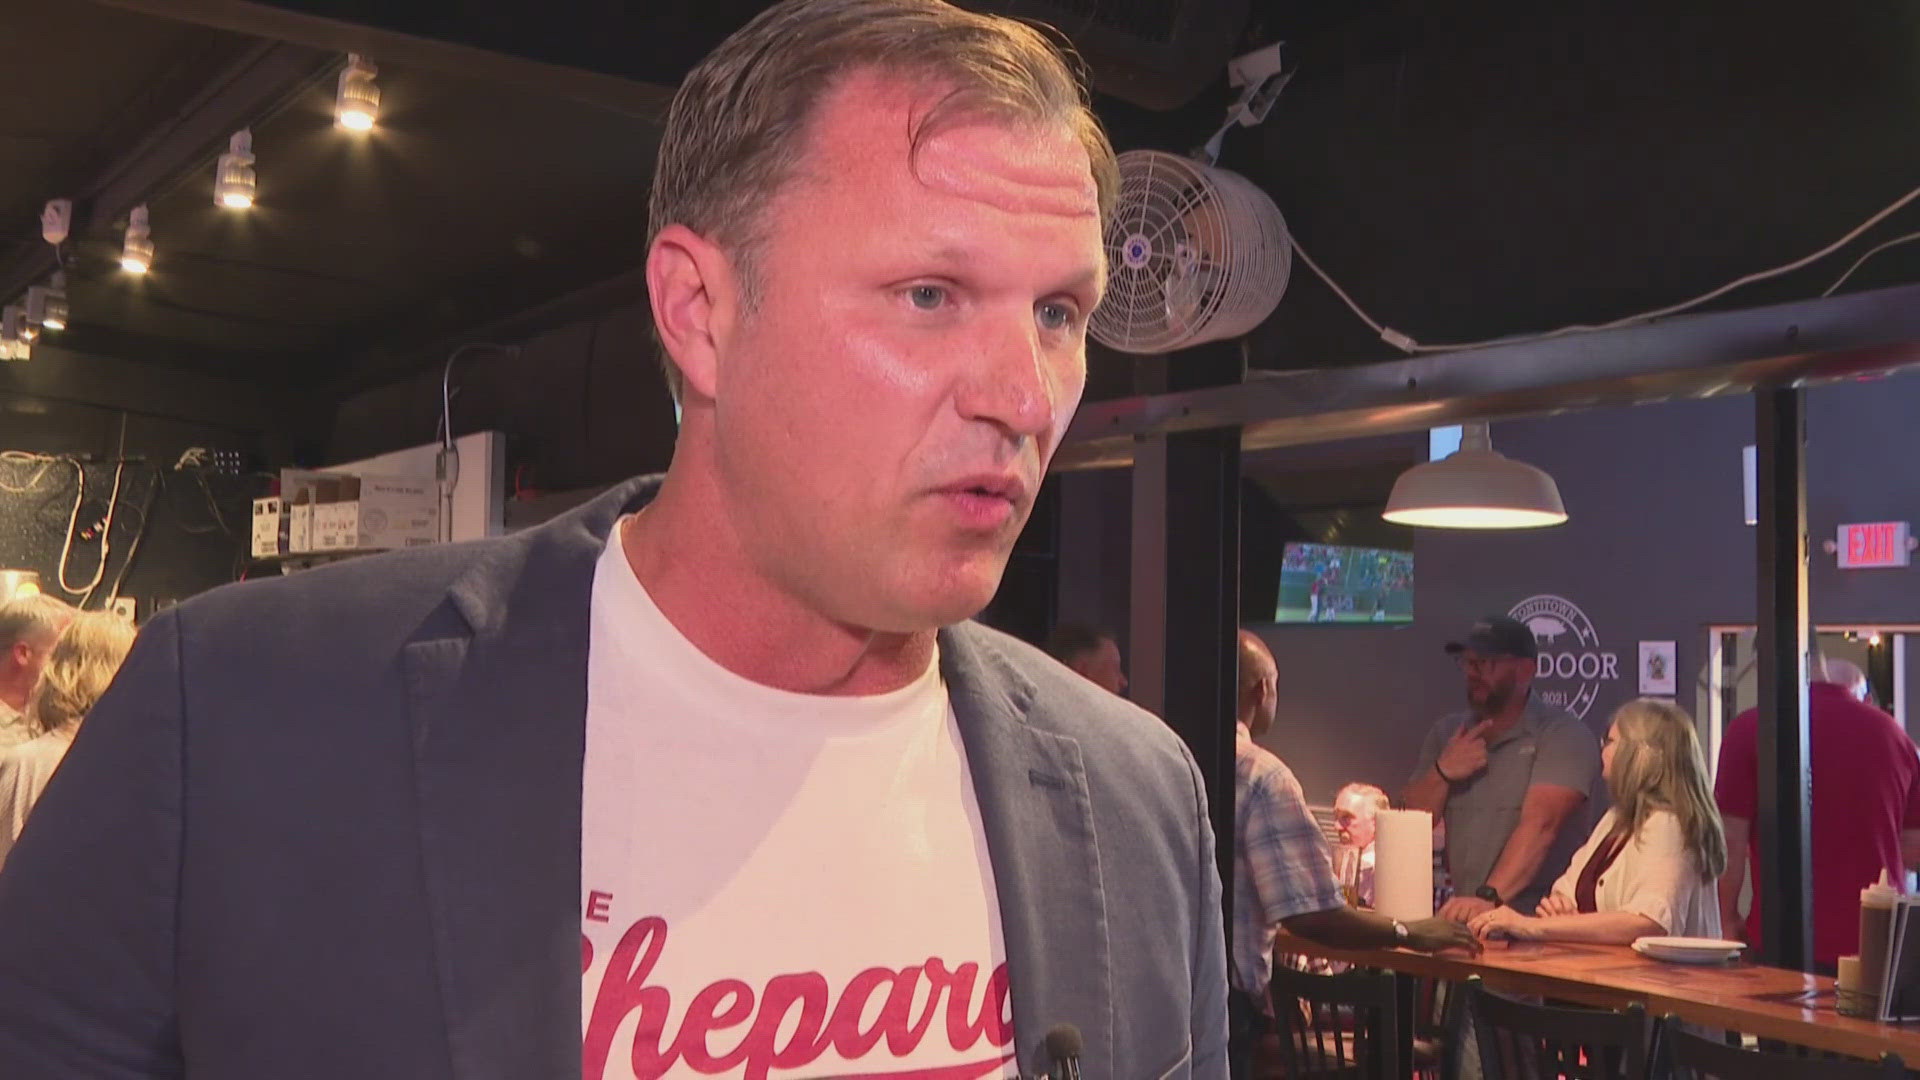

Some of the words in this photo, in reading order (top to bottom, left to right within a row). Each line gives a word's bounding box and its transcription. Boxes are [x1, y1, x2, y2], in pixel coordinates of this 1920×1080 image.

[1848, 523, 1896, 564] EXIT
[1535, 652, 1619, 679] DOOR
[1542, 691, 1568, 706] 2021
[582, 916, 1015, 1080] hepar
